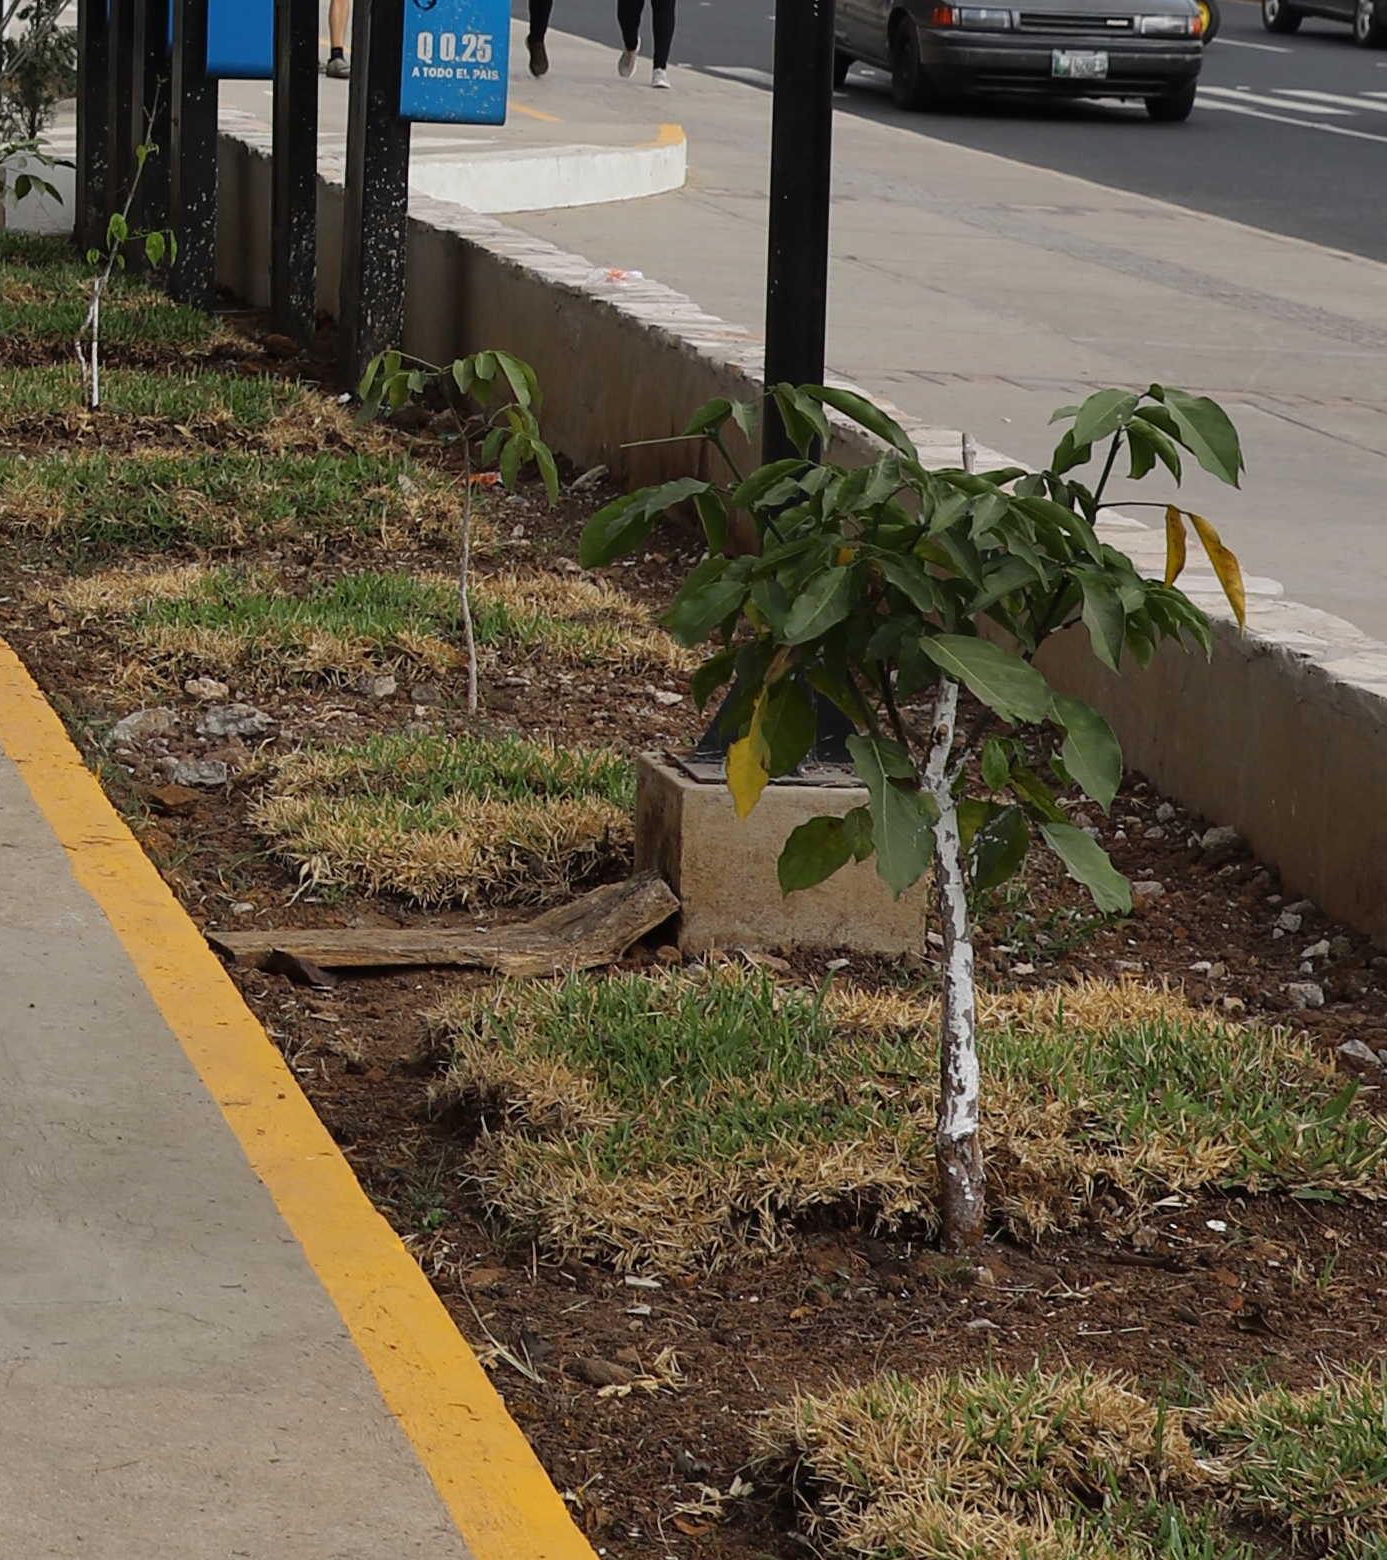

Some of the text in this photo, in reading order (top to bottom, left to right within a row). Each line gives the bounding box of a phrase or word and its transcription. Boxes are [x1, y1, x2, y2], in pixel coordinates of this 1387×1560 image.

[416, 31, 493, 64] Q 0.25
[411, 65, 421, 78] A
[422, 66, 454, 79] TODO
[456, 68, 471, 80] EL
